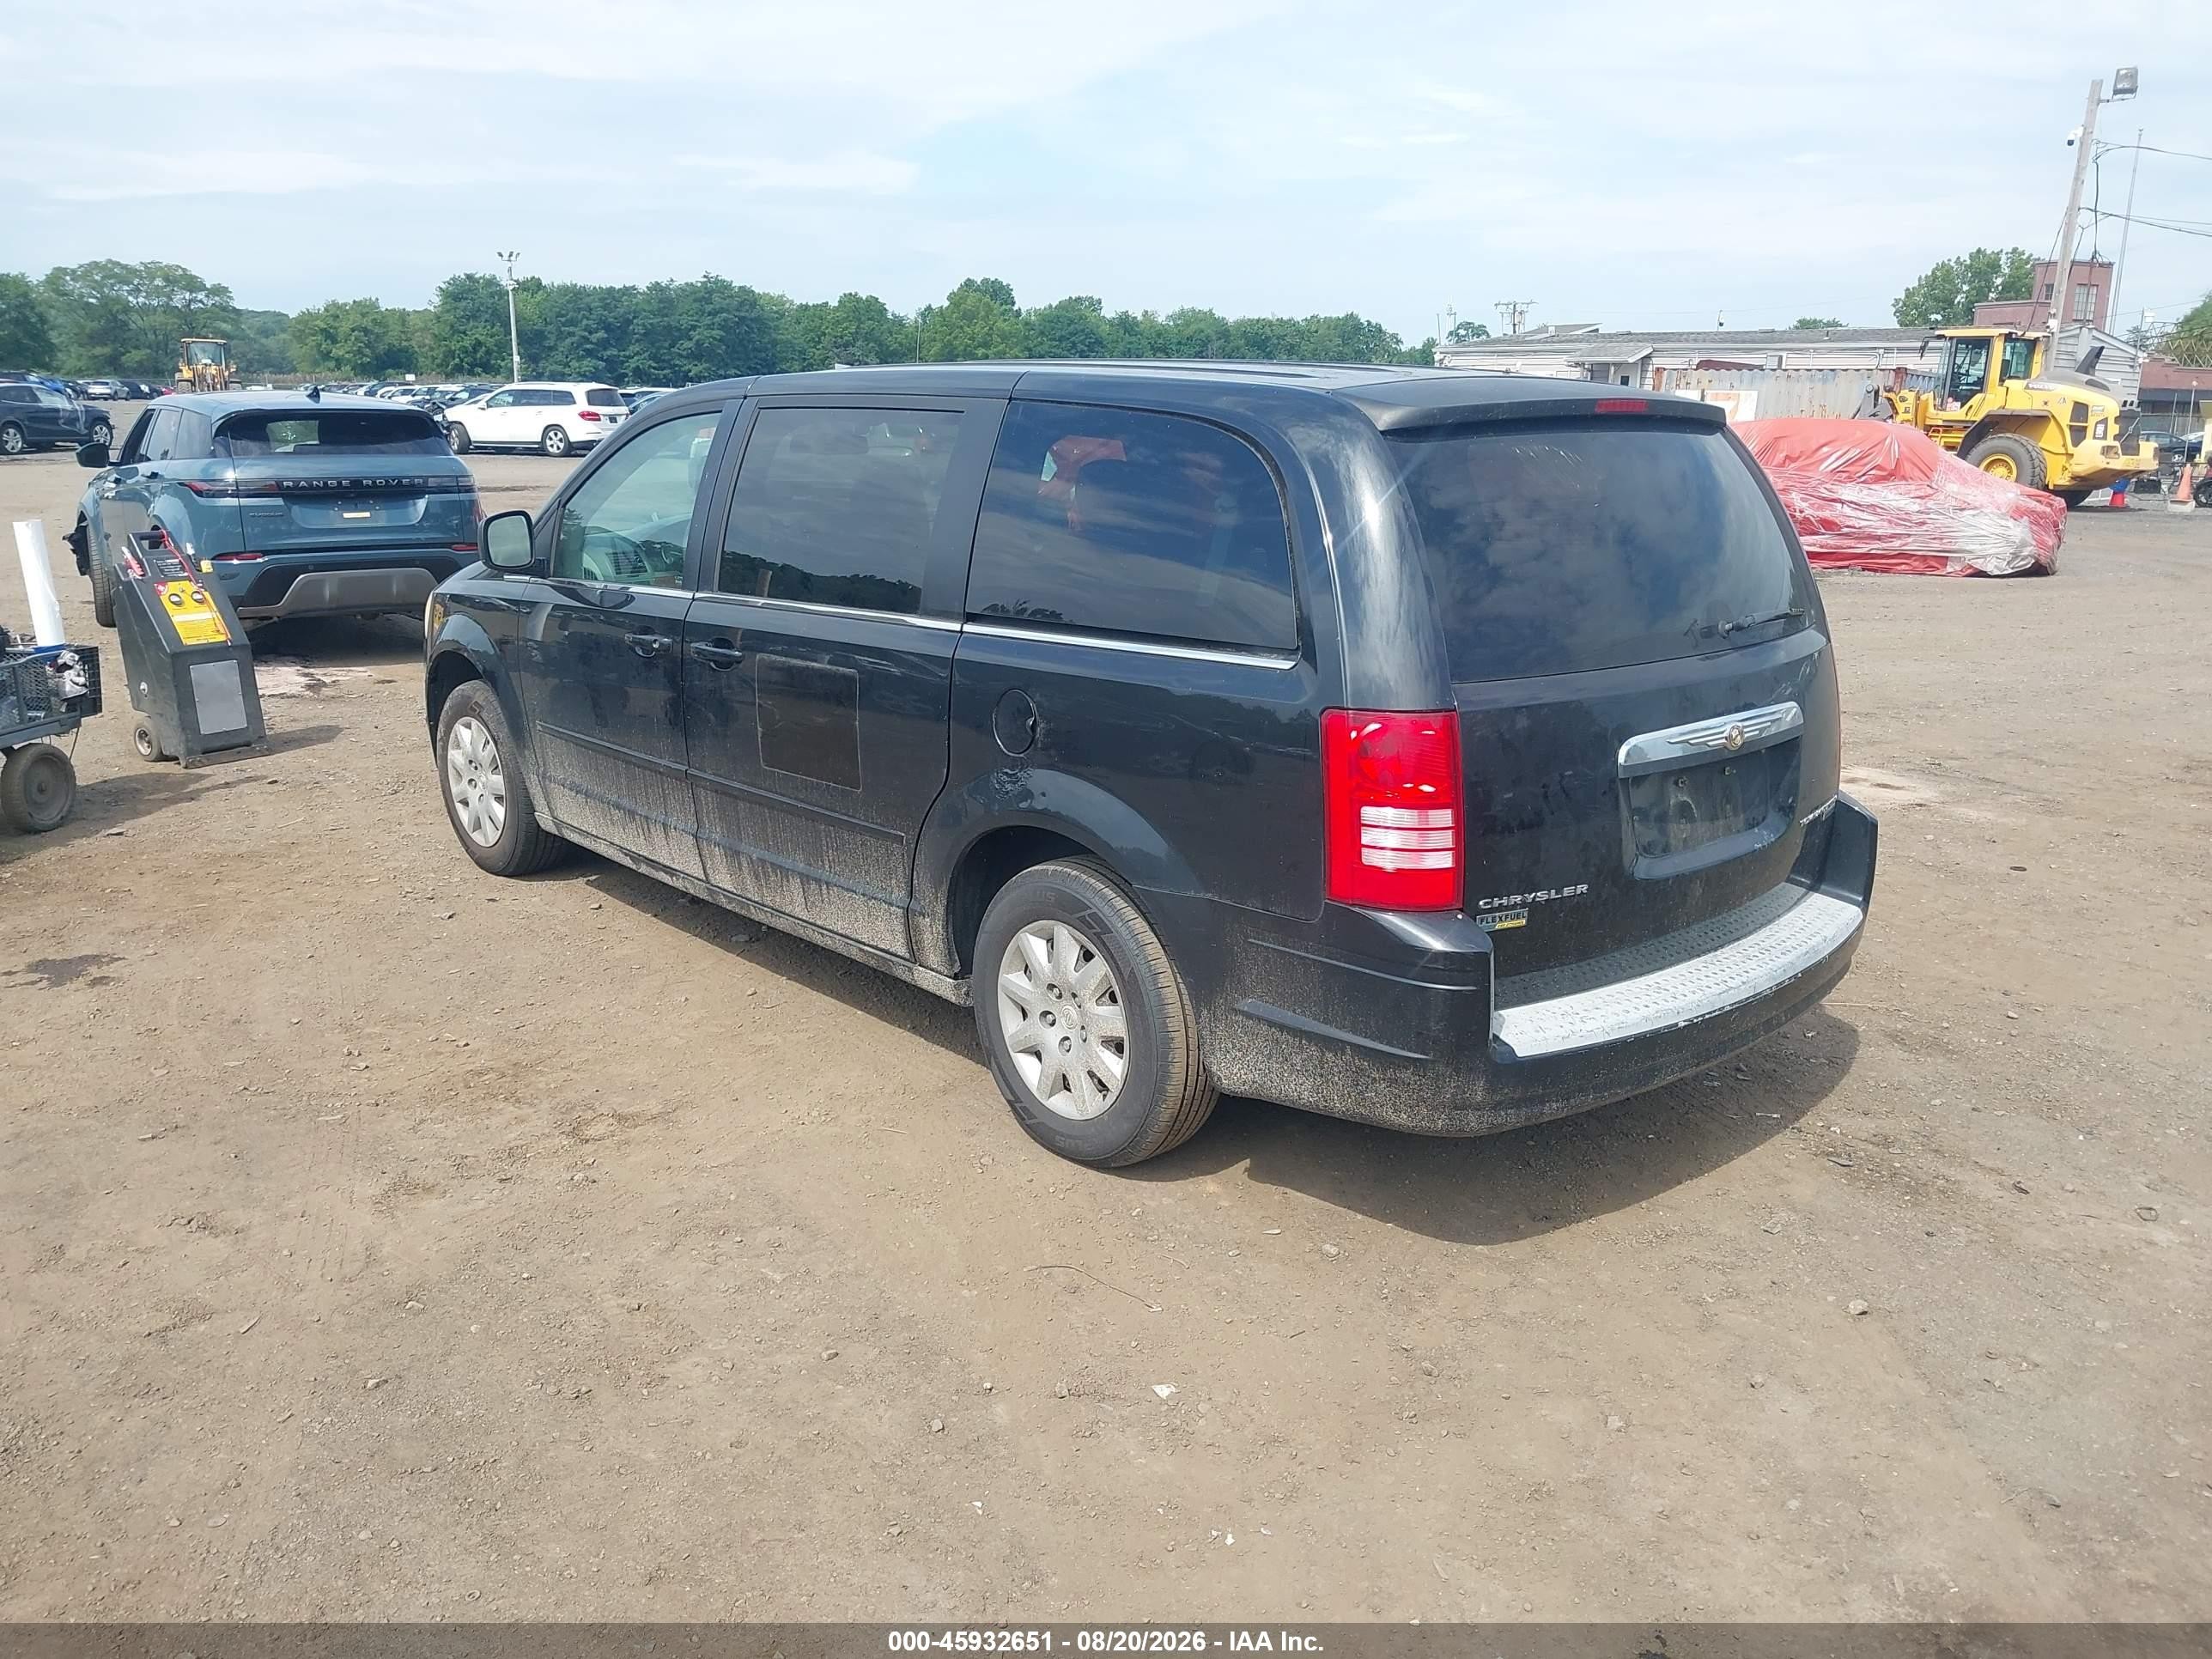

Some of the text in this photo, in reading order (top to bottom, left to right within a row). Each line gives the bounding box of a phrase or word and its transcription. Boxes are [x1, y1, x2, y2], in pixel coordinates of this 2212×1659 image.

[283, 478, 424, 489] RANGE ROVER
[1479, 884, 1589, 909] CHRYSLER
[1480, 911, 1527, 926] FLEXFUEL
